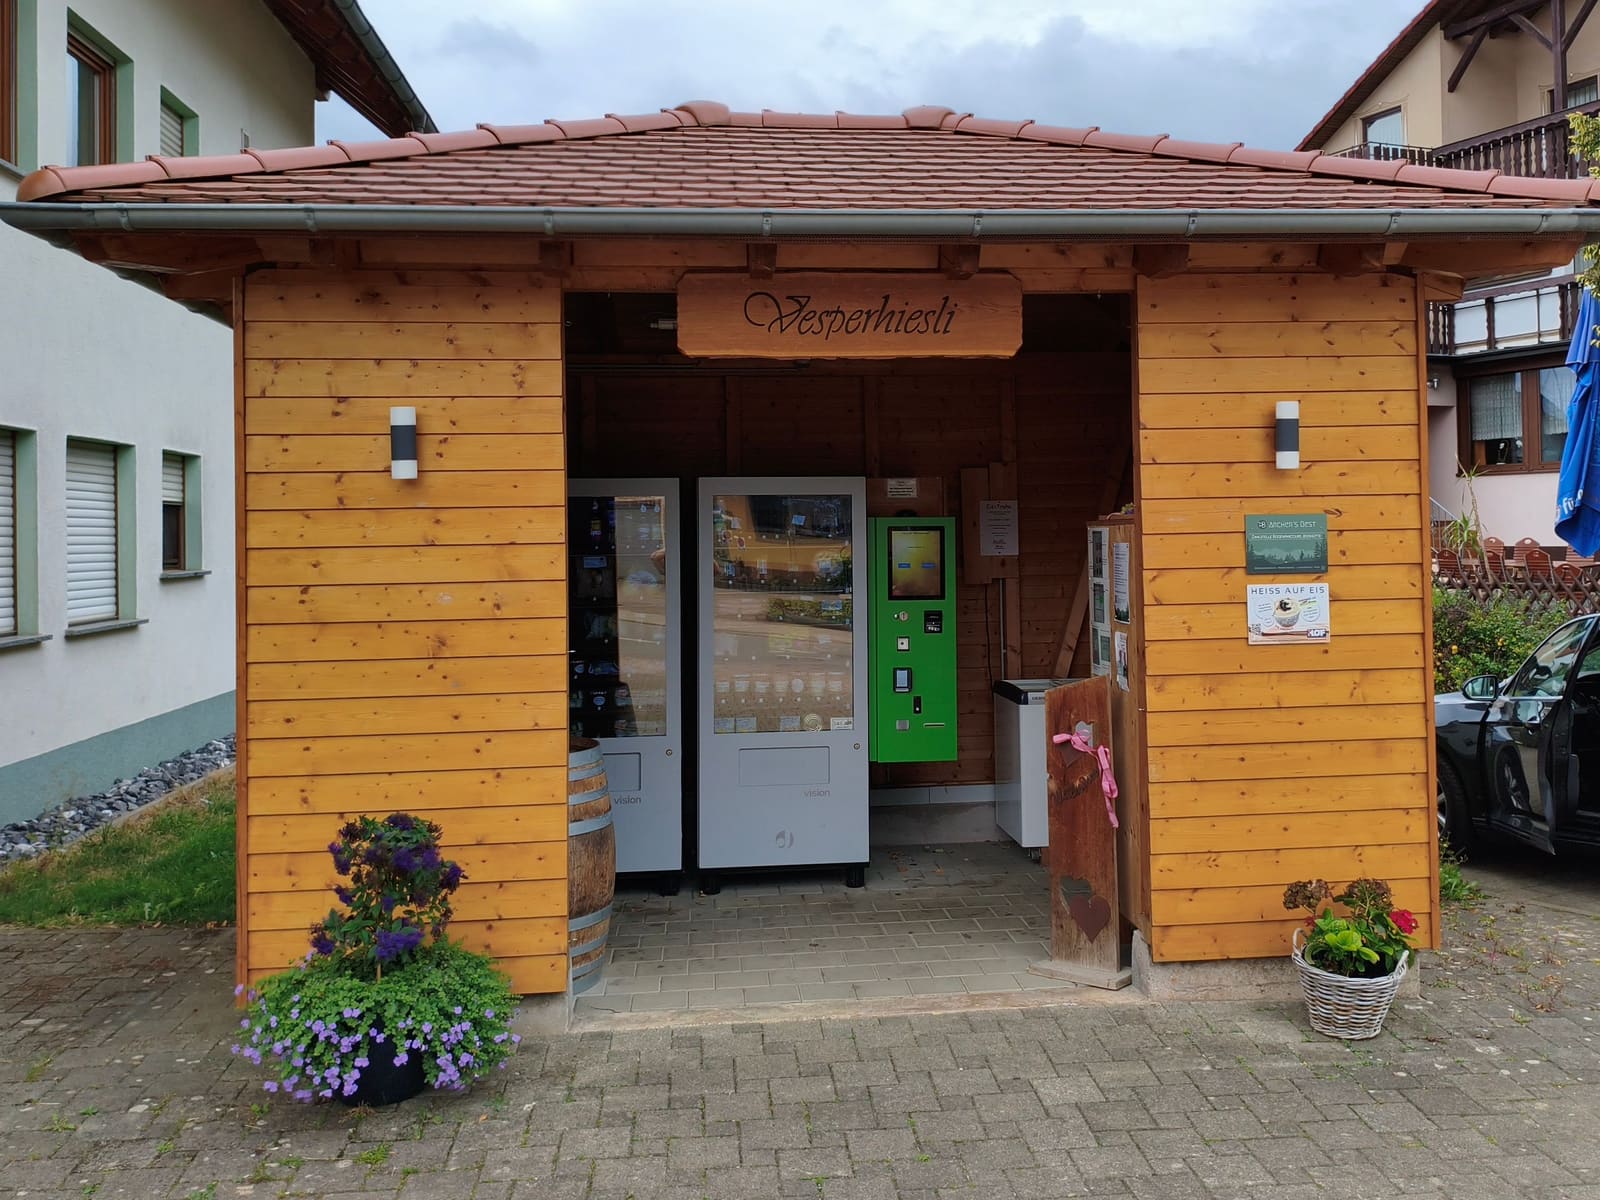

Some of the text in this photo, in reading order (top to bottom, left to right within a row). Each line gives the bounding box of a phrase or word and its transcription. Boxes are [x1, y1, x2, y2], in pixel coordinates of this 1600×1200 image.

[744, 291, 958, 341] Vesperhiesli
[1251, 587, 1281, 595] HEISS
[1285, 586, 1306, 594] AUF
[803, 788, 831, 798] vision
[613, 794, 642, 805] vision
